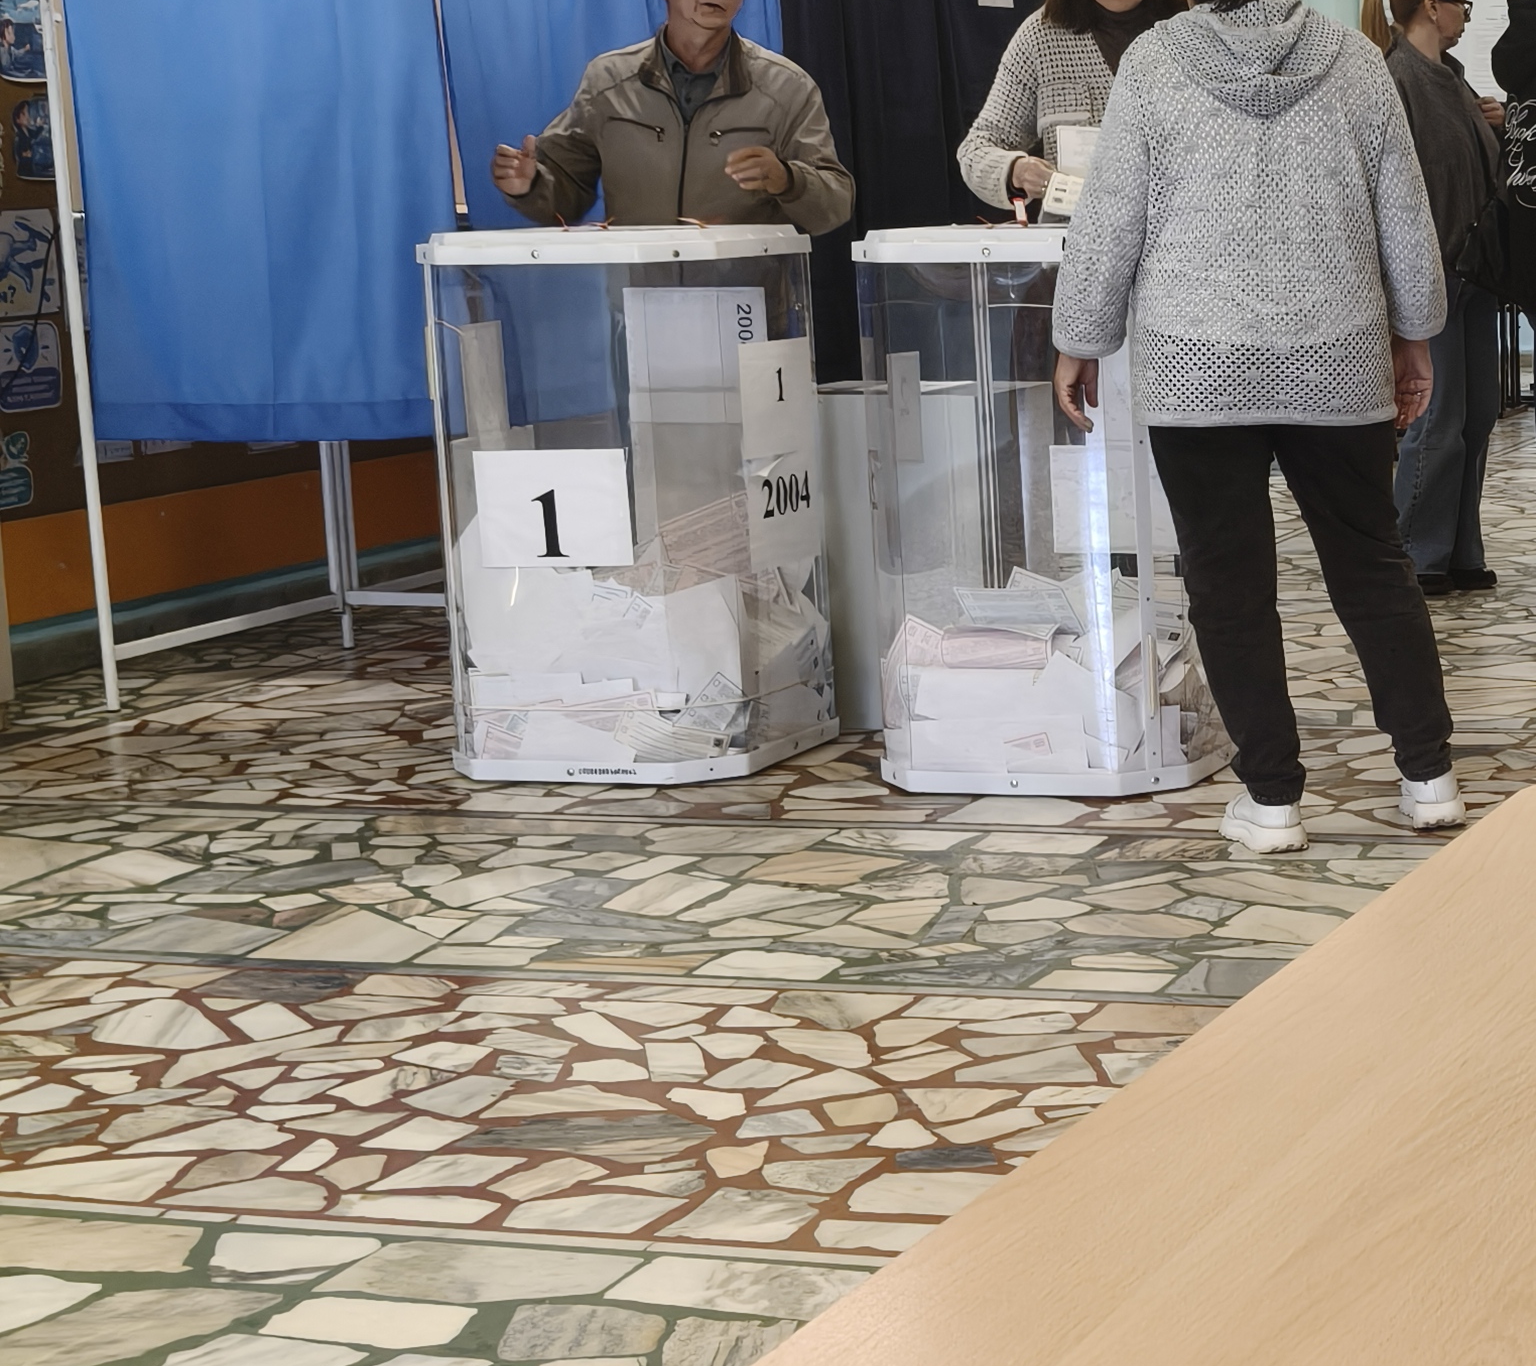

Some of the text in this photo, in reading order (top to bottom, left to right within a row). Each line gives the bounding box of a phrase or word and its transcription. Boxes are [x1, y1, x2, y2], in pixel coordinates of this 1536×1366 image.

[737, 303, 754, 345] 200
[775, 366, 785, 402] 1
[761, 470, 811, 520] 2004
[531, 488, 571, 558] 1
